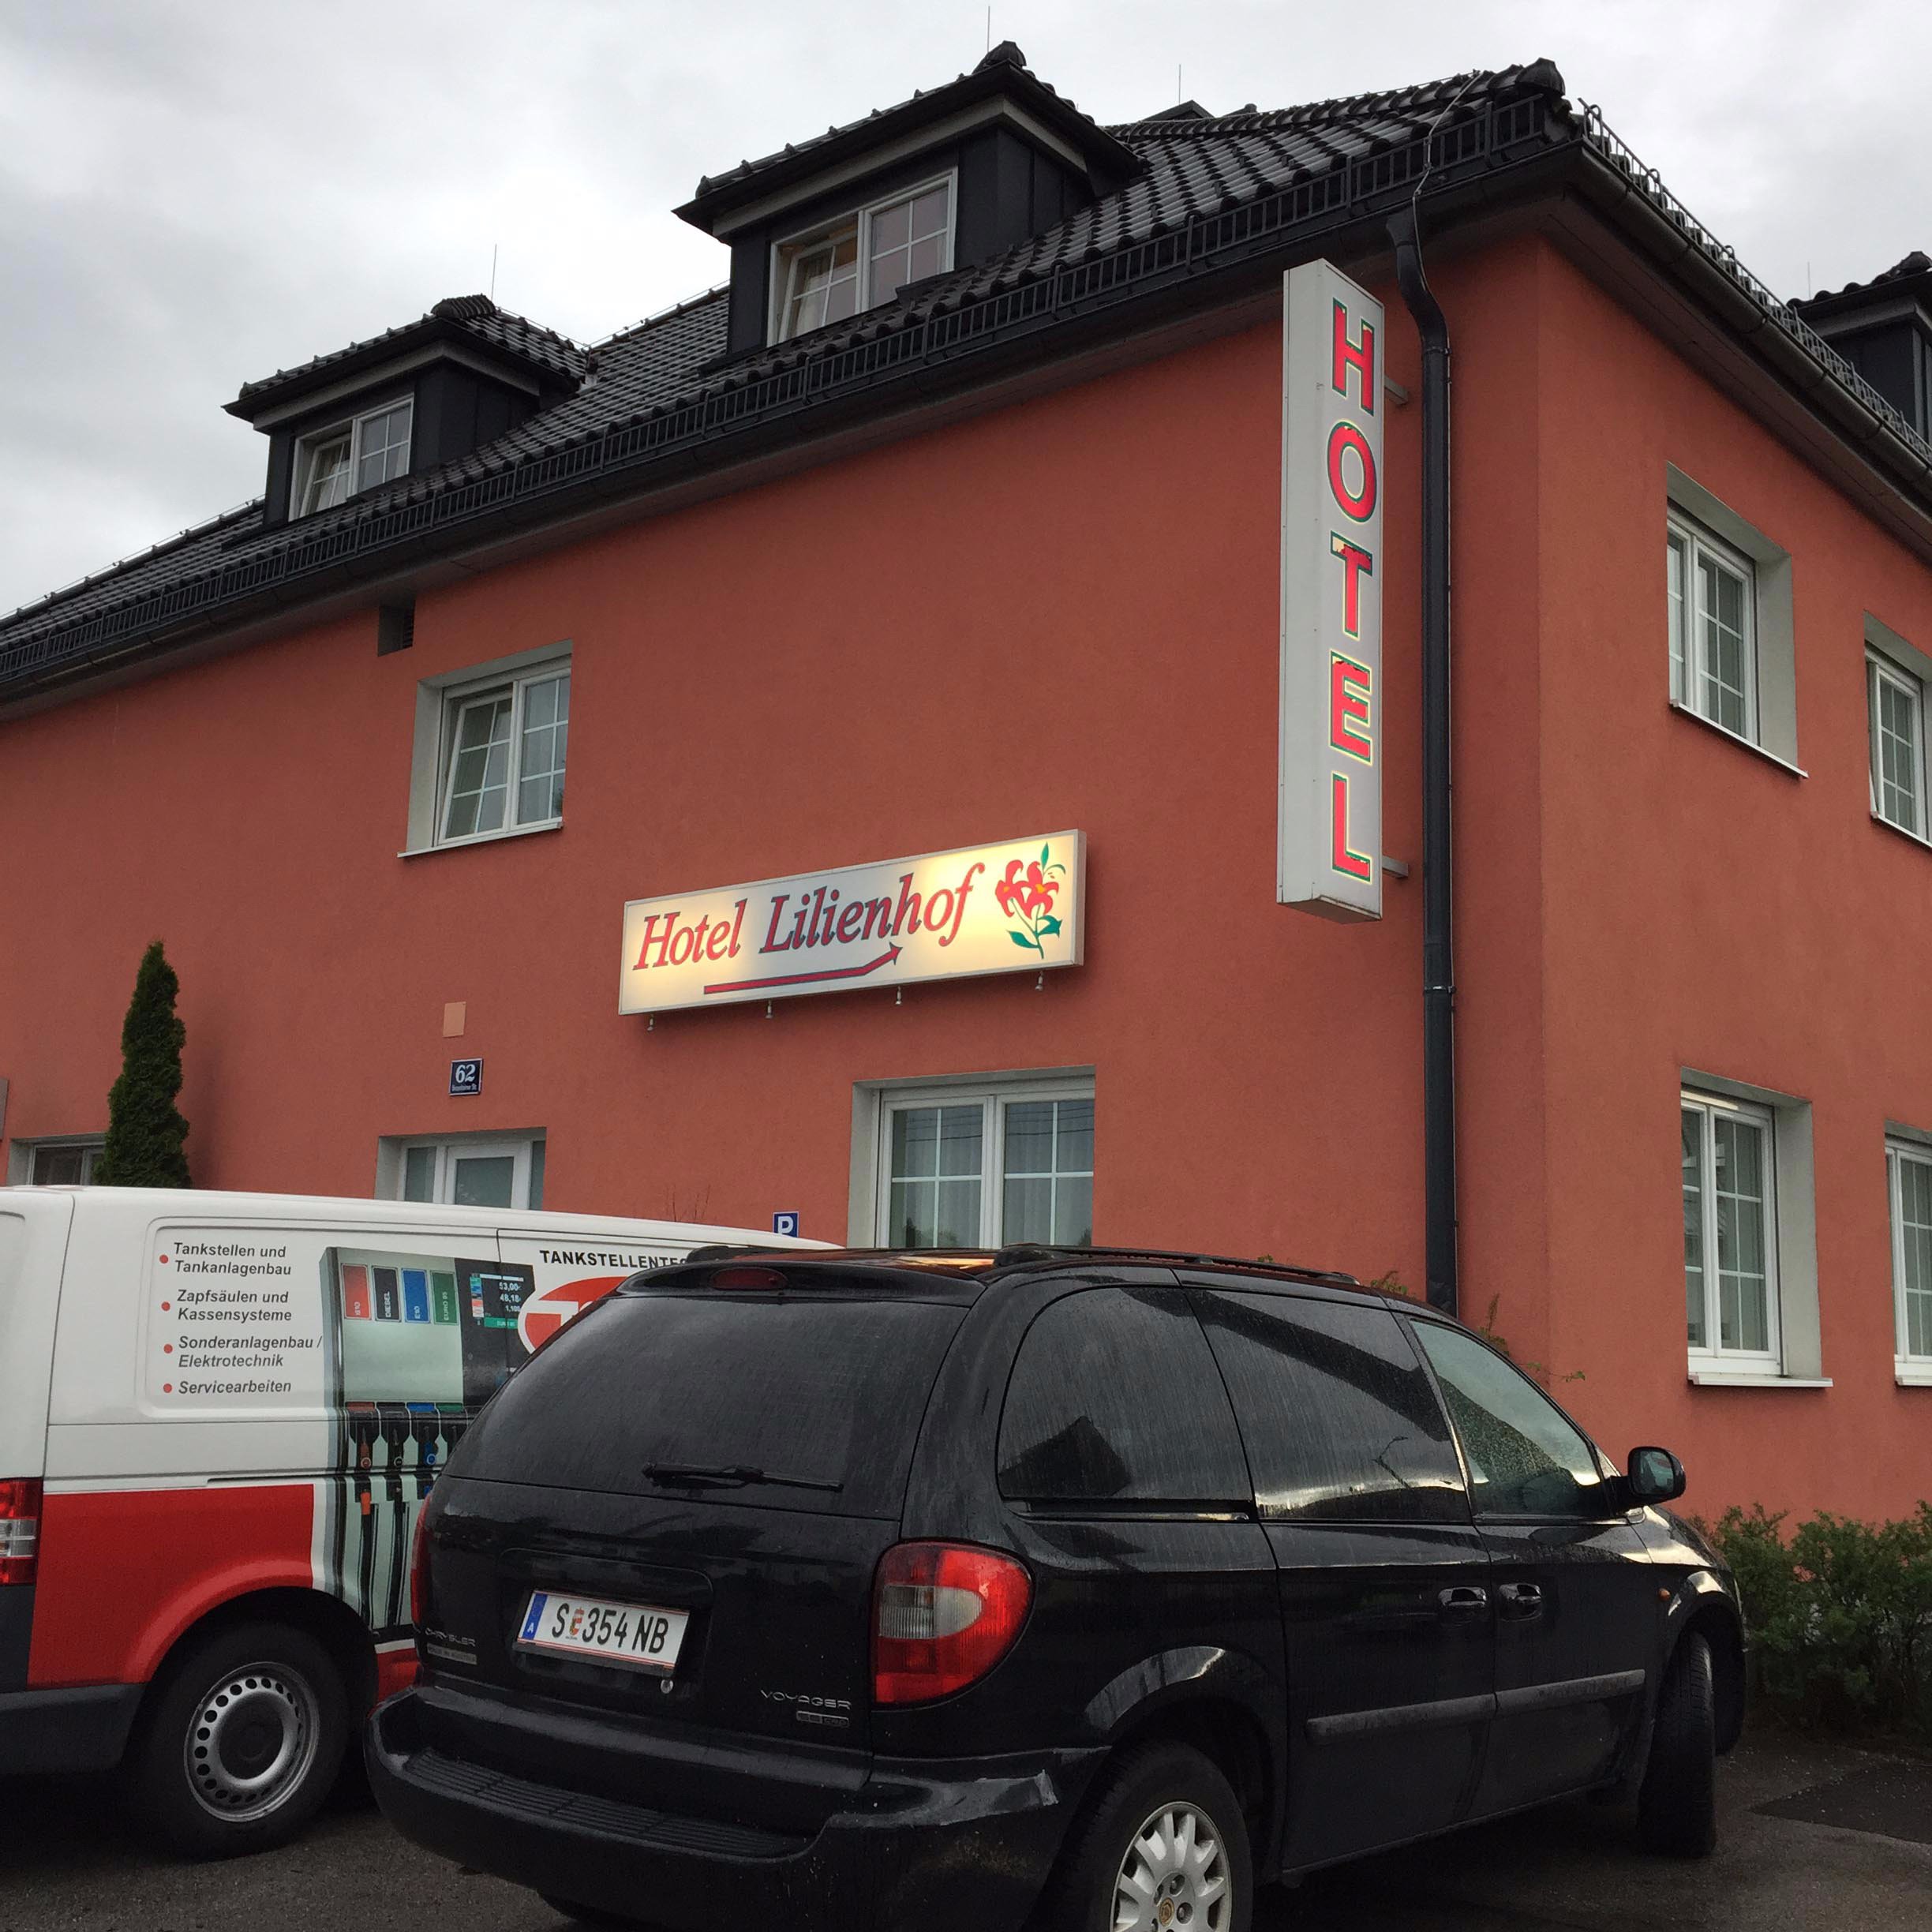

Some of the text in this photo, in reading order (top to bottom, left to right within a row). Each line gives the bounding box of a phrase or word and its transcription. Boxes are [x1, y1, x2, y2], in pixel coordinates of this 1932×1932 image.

[1326, 296, 1377, 885] HOTEL
[632, 862, 985, 970] Hotel Lilienhof
[455, 1064, 476, 1083] 62
[777, 1215, 794, 1234] P
[174, 1242, 286, 1258] Tankstellen und
[174, 1260, 291, 1277] Tankanlagenbau
[177, 1289, 289, 1305] Zapfsäulen und
[178, 1307, 292, 1324] Kassensysteme
[178, 1335, 313, 1352] Sonderanlagenbau
[178, 1354, 284, 1368] Elektrotechnik
[178, 1380, 291, 1395] Servicearbeiten
[526, 1622, 534, 1634] A
[632, 1615, 669, 1654] NB
[760, 1689, 852, 1710] VOYAGER
